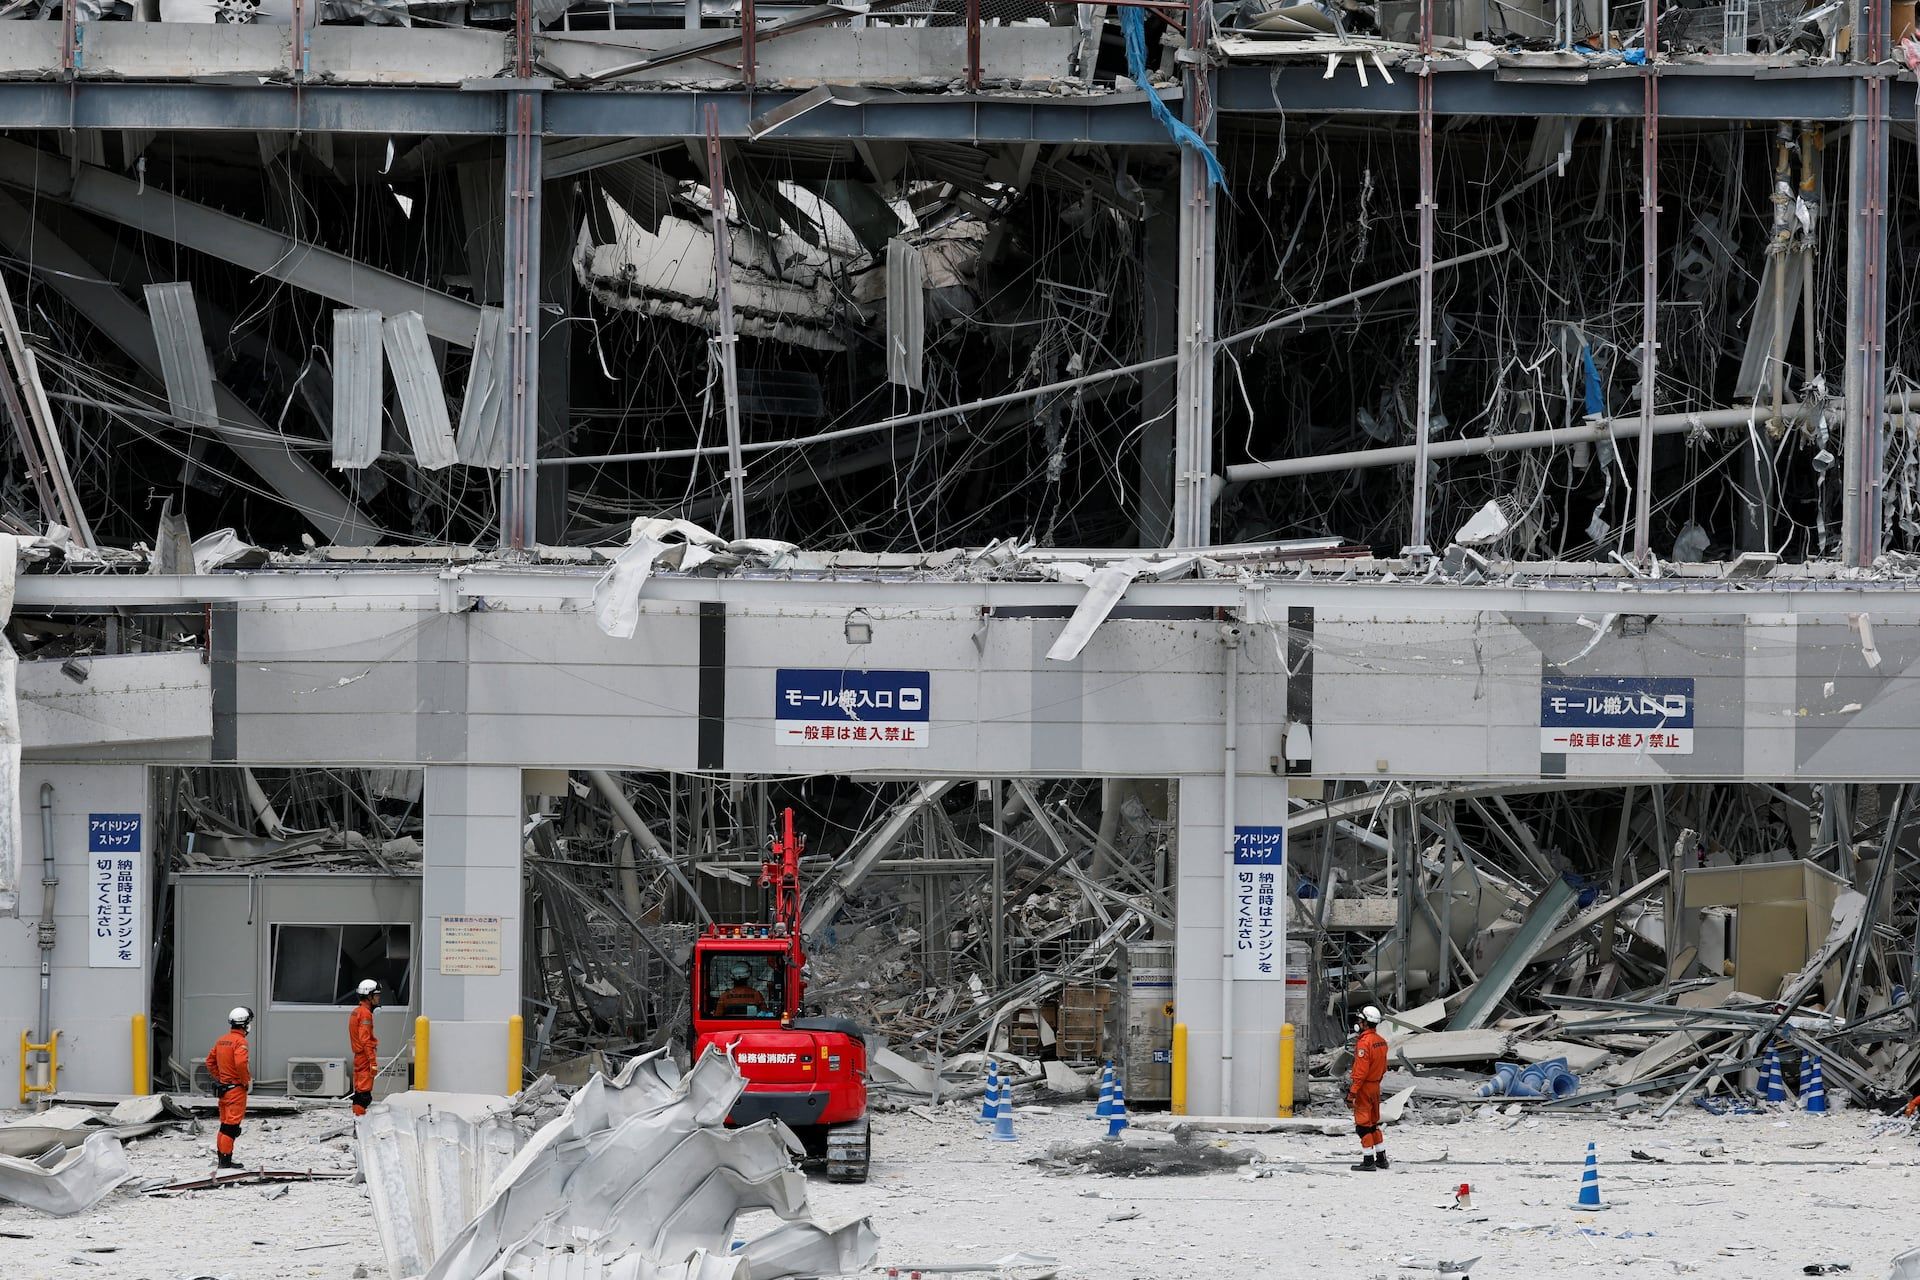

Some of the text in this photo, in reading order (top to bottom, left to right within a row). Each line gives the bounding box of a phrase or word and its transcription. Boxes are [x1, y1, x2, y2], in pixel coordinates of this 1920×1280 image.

[785, 688, 893, 709] モール搬入口
[1550, 696, 1657, 715] モール搬入口
[788, 725, 915, 741] 一般車は進入禁止
[1553, 733, 1680, 748] 一般車は進入禁止
[91, 820, 139, 832] アイドリング
[99, 834, 131, 845] ストップ
[1233, 833, 1281, 845] アイドリング
[1240, 847, 1273, 858] ストップ
[97, 859, 112, 938] 切ってください
[117, 859, 133, 961] 納品時はエンジンを
[1238, 872, 1253, 950] 切ってください
[1258, 872, 1274, 973] 納品時はエンジンを
[738, 1052, 797, 1064] 総務省消防庁
